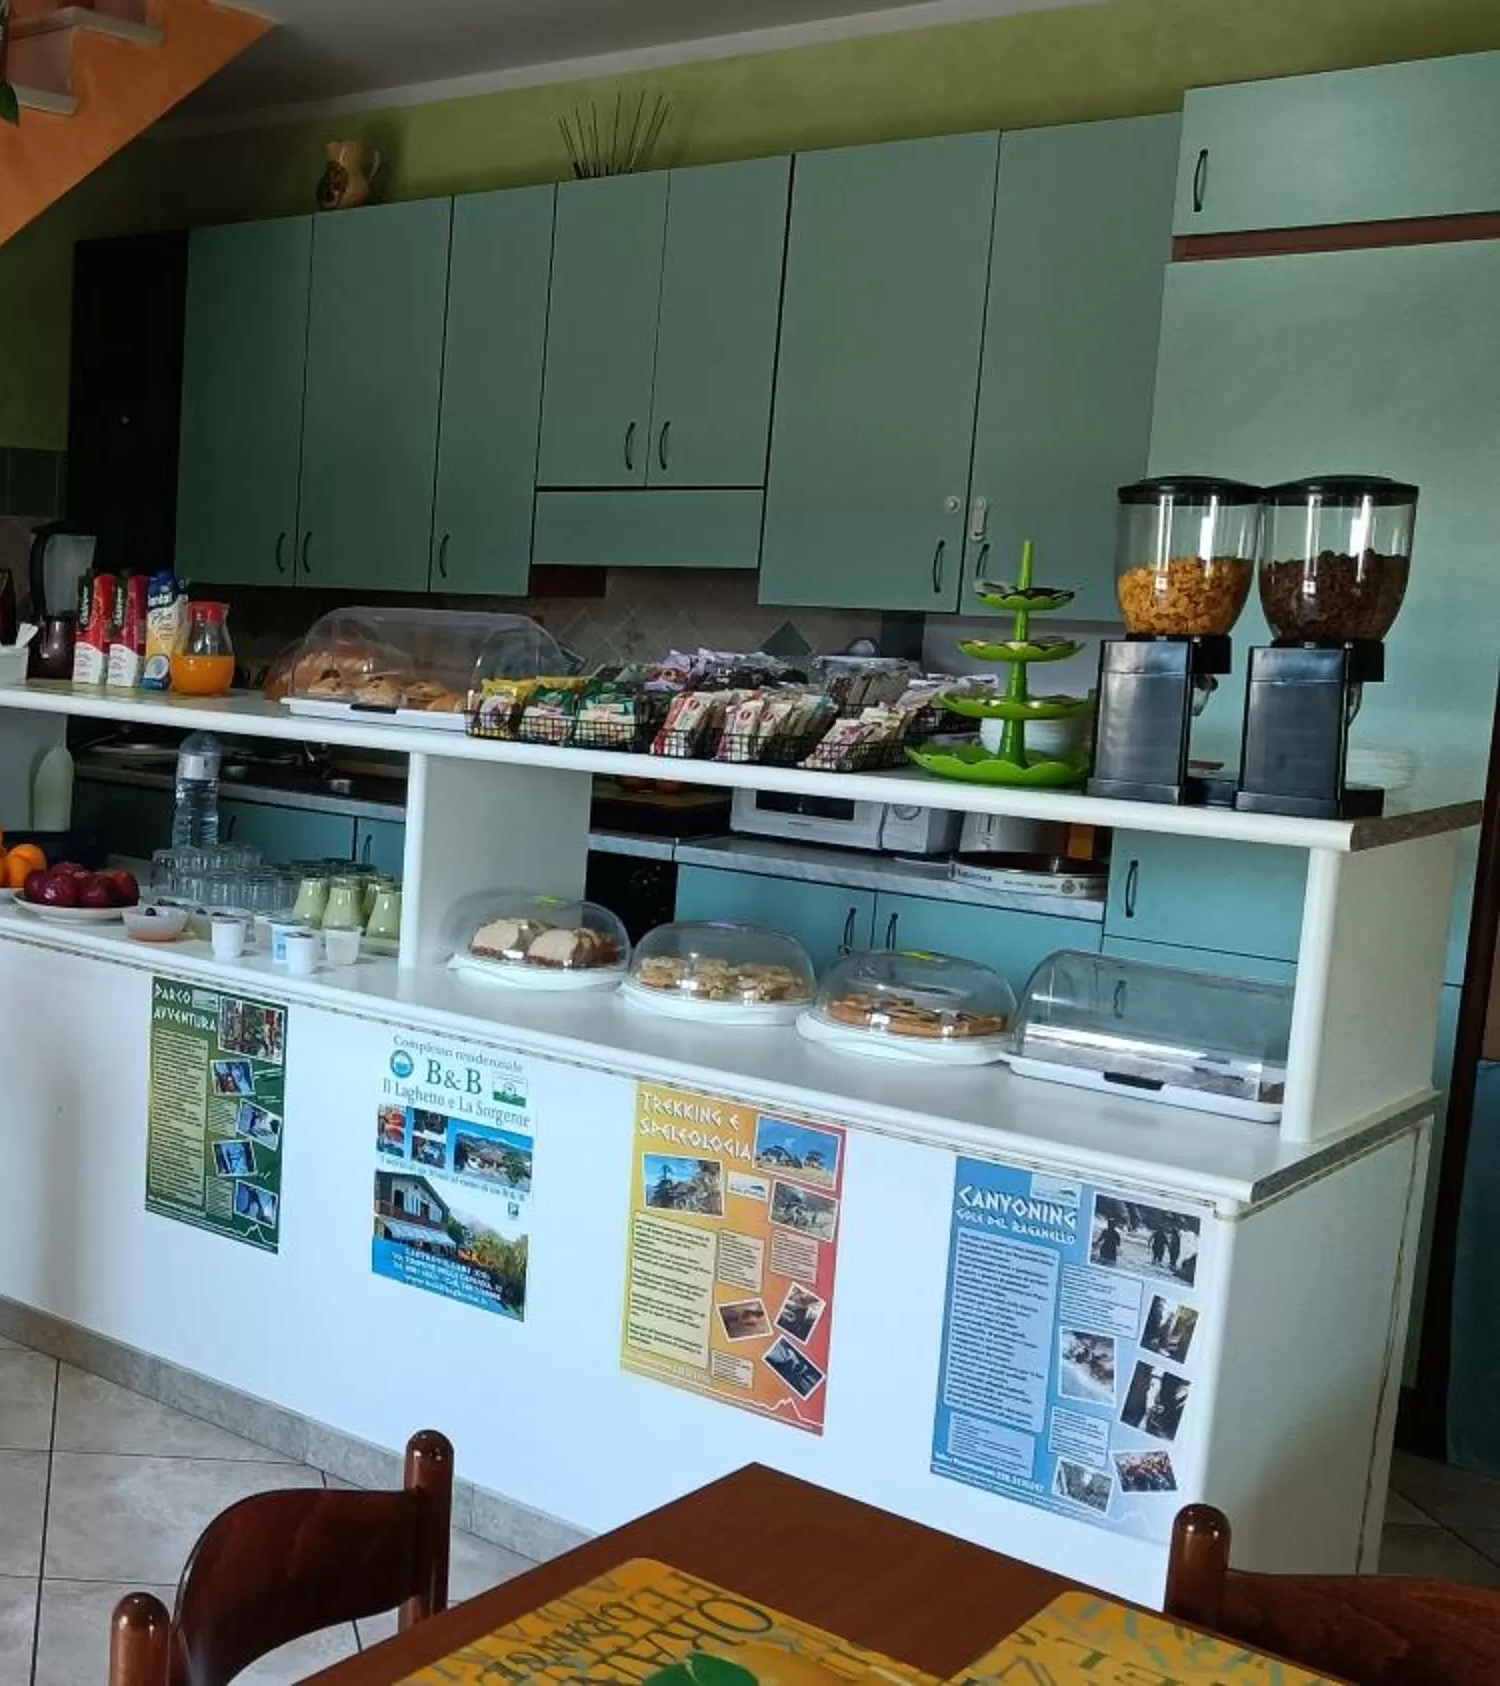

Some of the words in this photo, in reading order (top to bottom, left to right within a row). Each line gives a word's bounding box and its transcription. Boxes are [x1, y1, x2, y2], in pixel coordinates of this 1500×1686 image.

[154, 982, 191, 1005] PARCO
[153, 1004, 217, 1032] AVVENTURA
[425, 1059, 482, 1095] B&B
[395, 1082, 445, 1105] Laghetto
[459, 1096, 473, 1113] La
[475, 1103, 531, 1128] Sorgente
[640, 1091, 723, 1127] TREKKING
[639, 1117, 751, 1161] SPELEOLOGIA
[958, 1184, 1077, 1229] CANYONING
